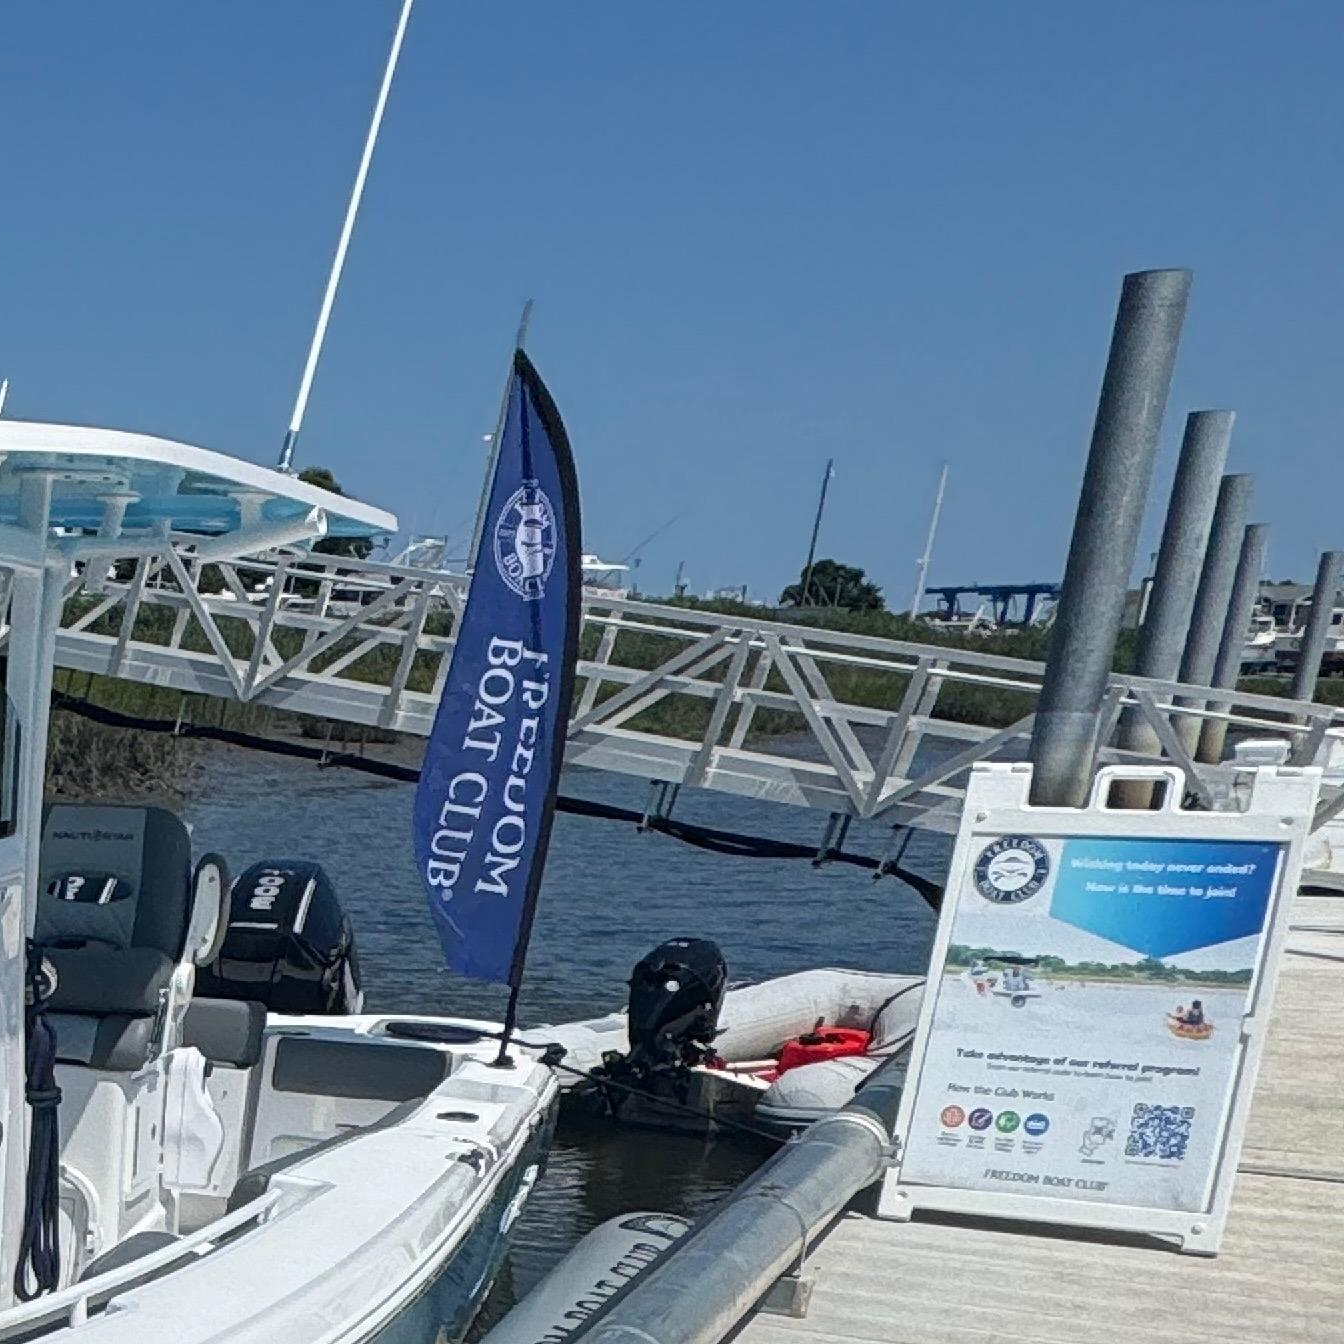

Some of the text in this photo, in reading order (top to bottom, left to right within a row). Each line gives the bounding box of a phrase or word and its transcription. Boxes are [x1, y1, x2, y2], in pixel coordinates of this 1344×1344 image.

[460, 634, 524, 763] BOAT
[1126, 860, 1164, 873] today
[1167, 864, 1205, 873] never
[1207, 863, 1257, 875] ended?
[957, 1048, 983, 1059] Take
[987, 1052, 1050, 1066] advantage
[1053, 1057, 1067, 1066] of
[1069, 1059, 1089, 1068] our
[1093, 1059, 1139, 1071] referral
[948, 1083, 1055, 1101] How the Club Works
[983, 1168, 1040, 1184] FREEDOM
[1042, 1174, 1073, 1188] BOAT
